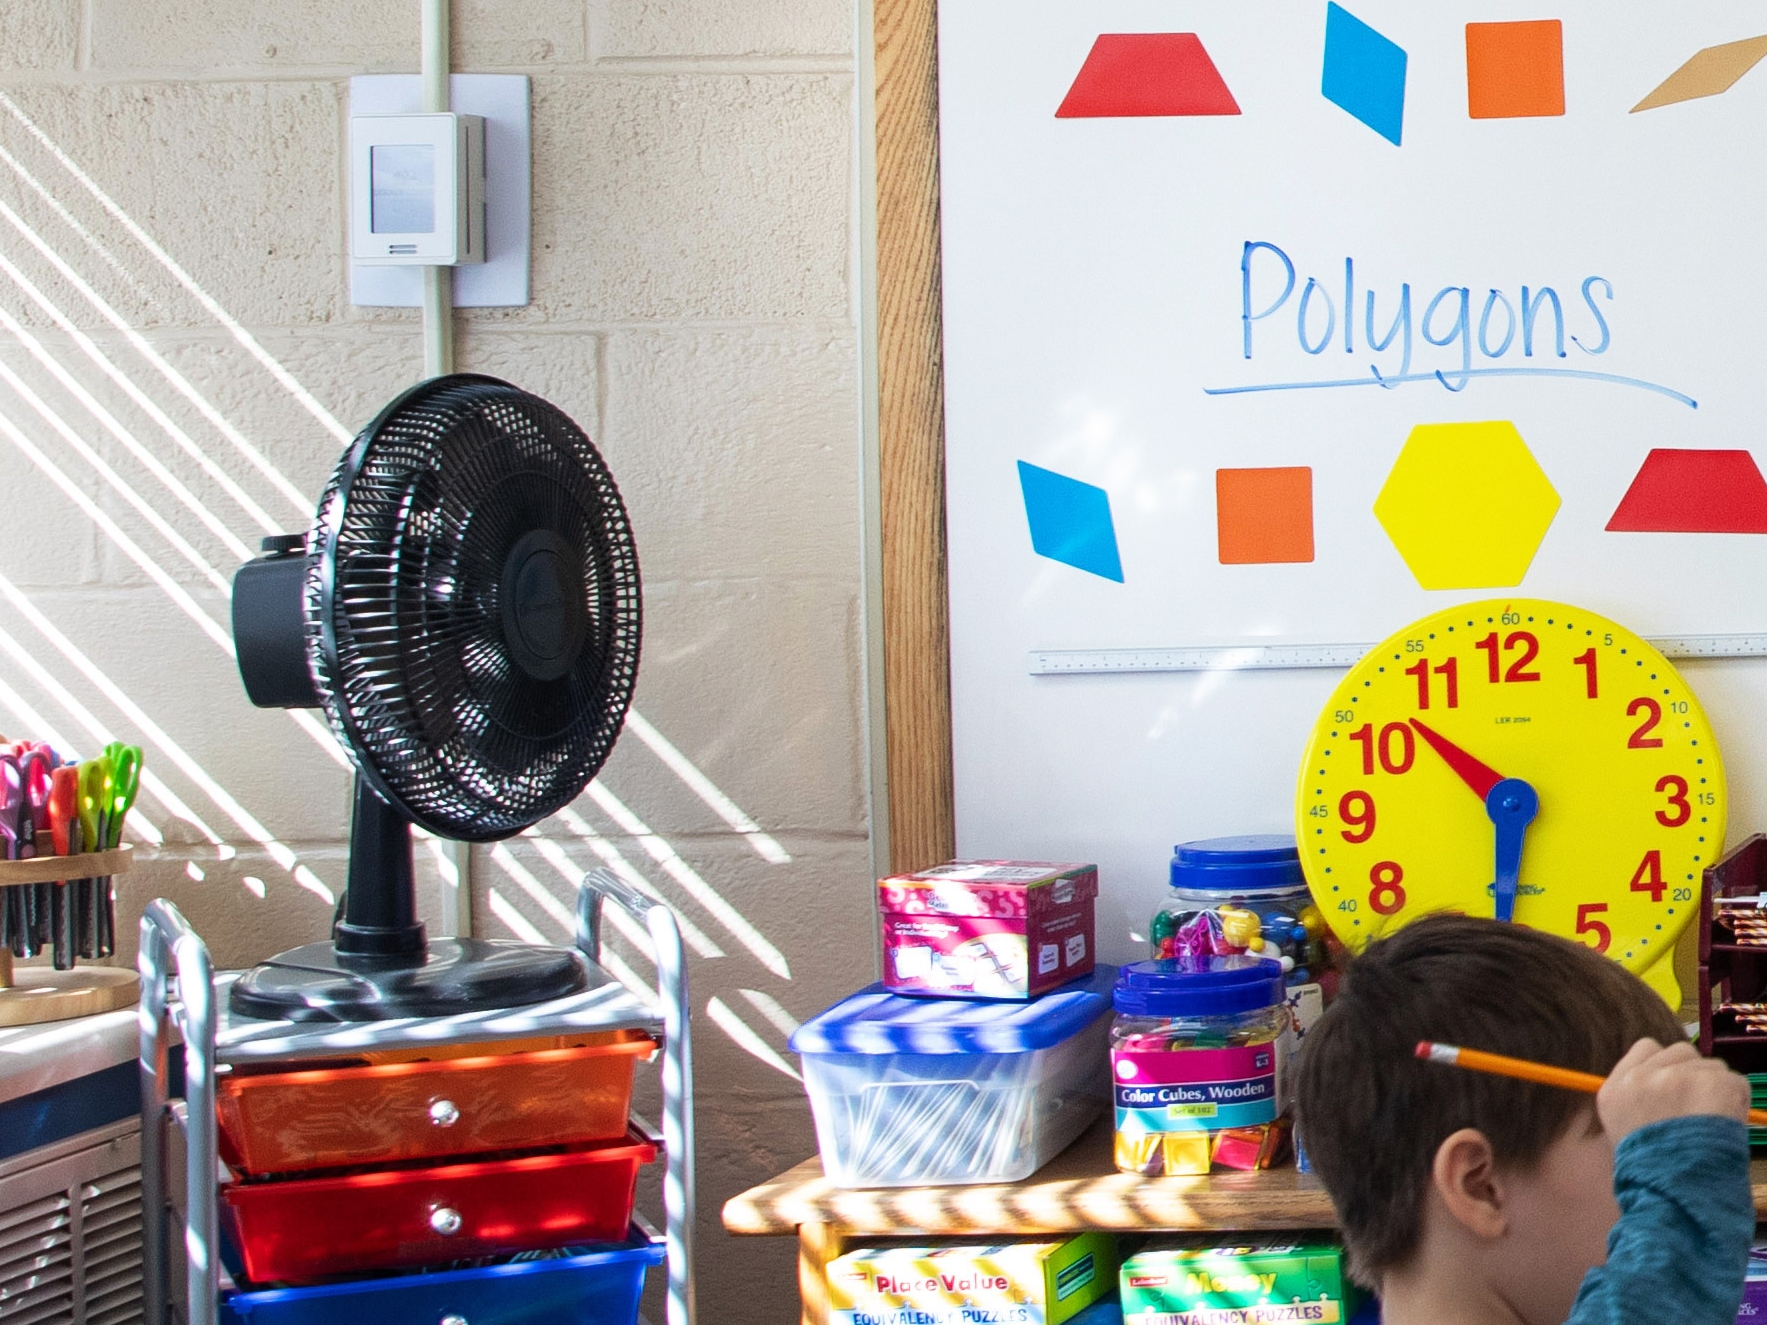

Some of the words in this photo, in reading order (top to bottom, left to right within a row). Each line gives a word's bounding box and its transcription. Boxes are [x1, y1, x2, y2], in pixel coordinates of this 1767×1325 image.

[1239, 238, 1617, 394] Polygons
[1501, 612, 1520, 625] 60
[1405, 639, 1425, 653] 55
[1475, 630, 1541, 684] 12
[1335, 709, 1354, 723] 50
[1670, 701, 1688, 714] 10
[1349, 721, 1416, 776] 10
[1654, 775, 1692, 828] 3
[1338, 789, 1376, 844] 9
[1121, 1089, 1156, 1102] Color
[1158, 1088, 1205, 1102] Cubes,
[1209, 1082, 1265, 1099] Wooden
[876, 1275, 938, 1293] Place
[941, 1273, 1008, 1291] Value
[1185, 1272, 1276, 1295] Money
[1257, 1306, 1323, 1322] PUZZLES
